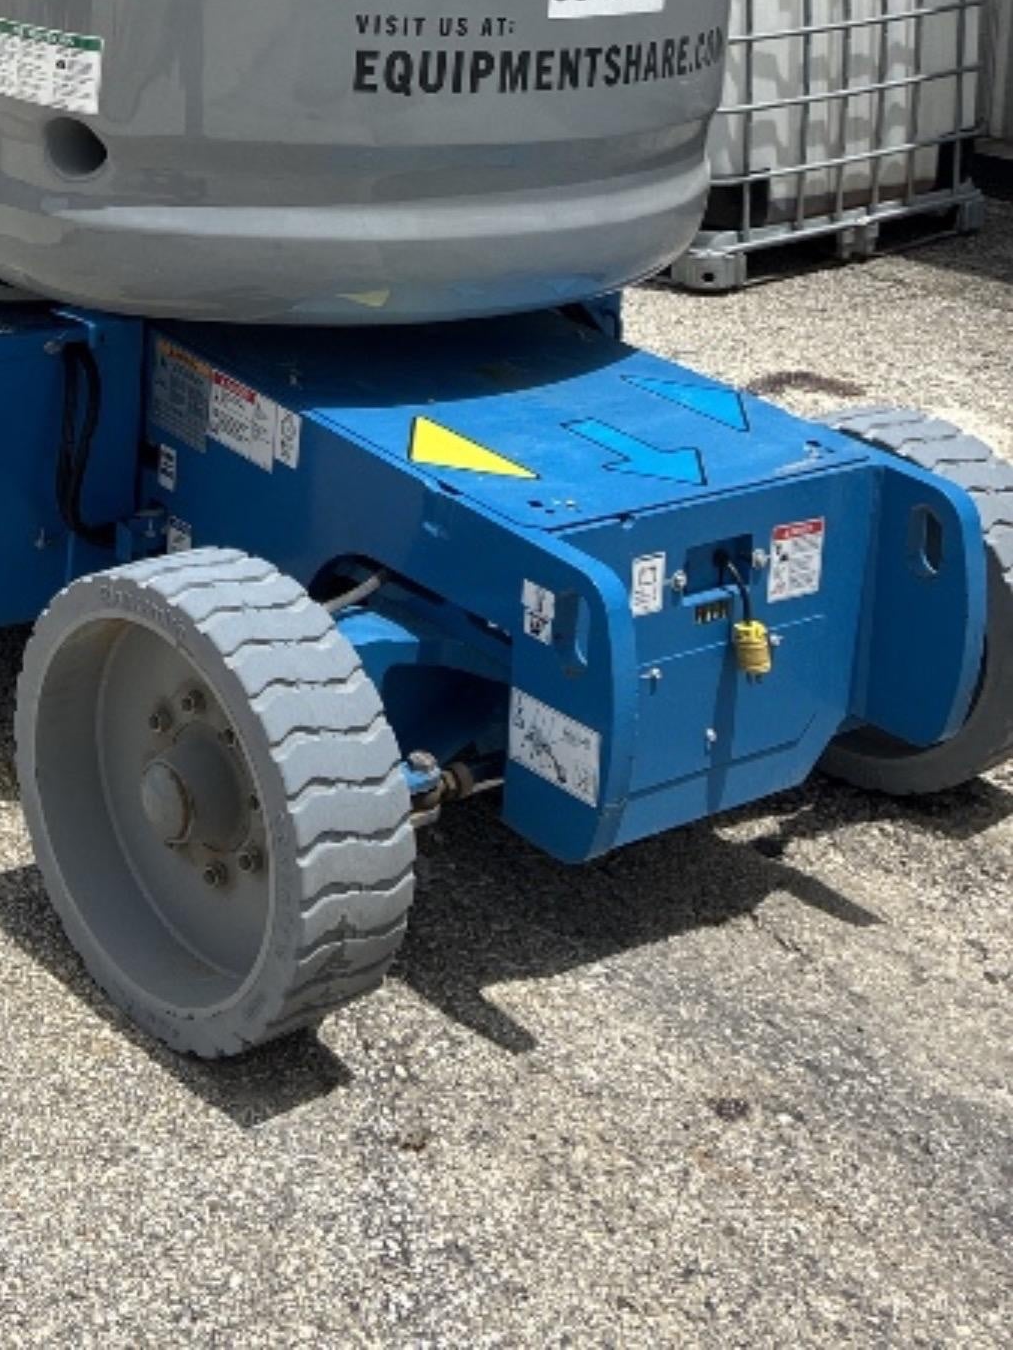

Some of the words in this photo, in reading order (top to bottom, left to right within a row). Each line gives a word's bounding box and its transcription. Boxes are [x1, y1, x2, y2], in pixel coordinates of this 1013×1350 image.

[356, 14, 426, 37] VISIT
[439, 17, 469, 37] US
[481, 17, 516, 37] AT:
